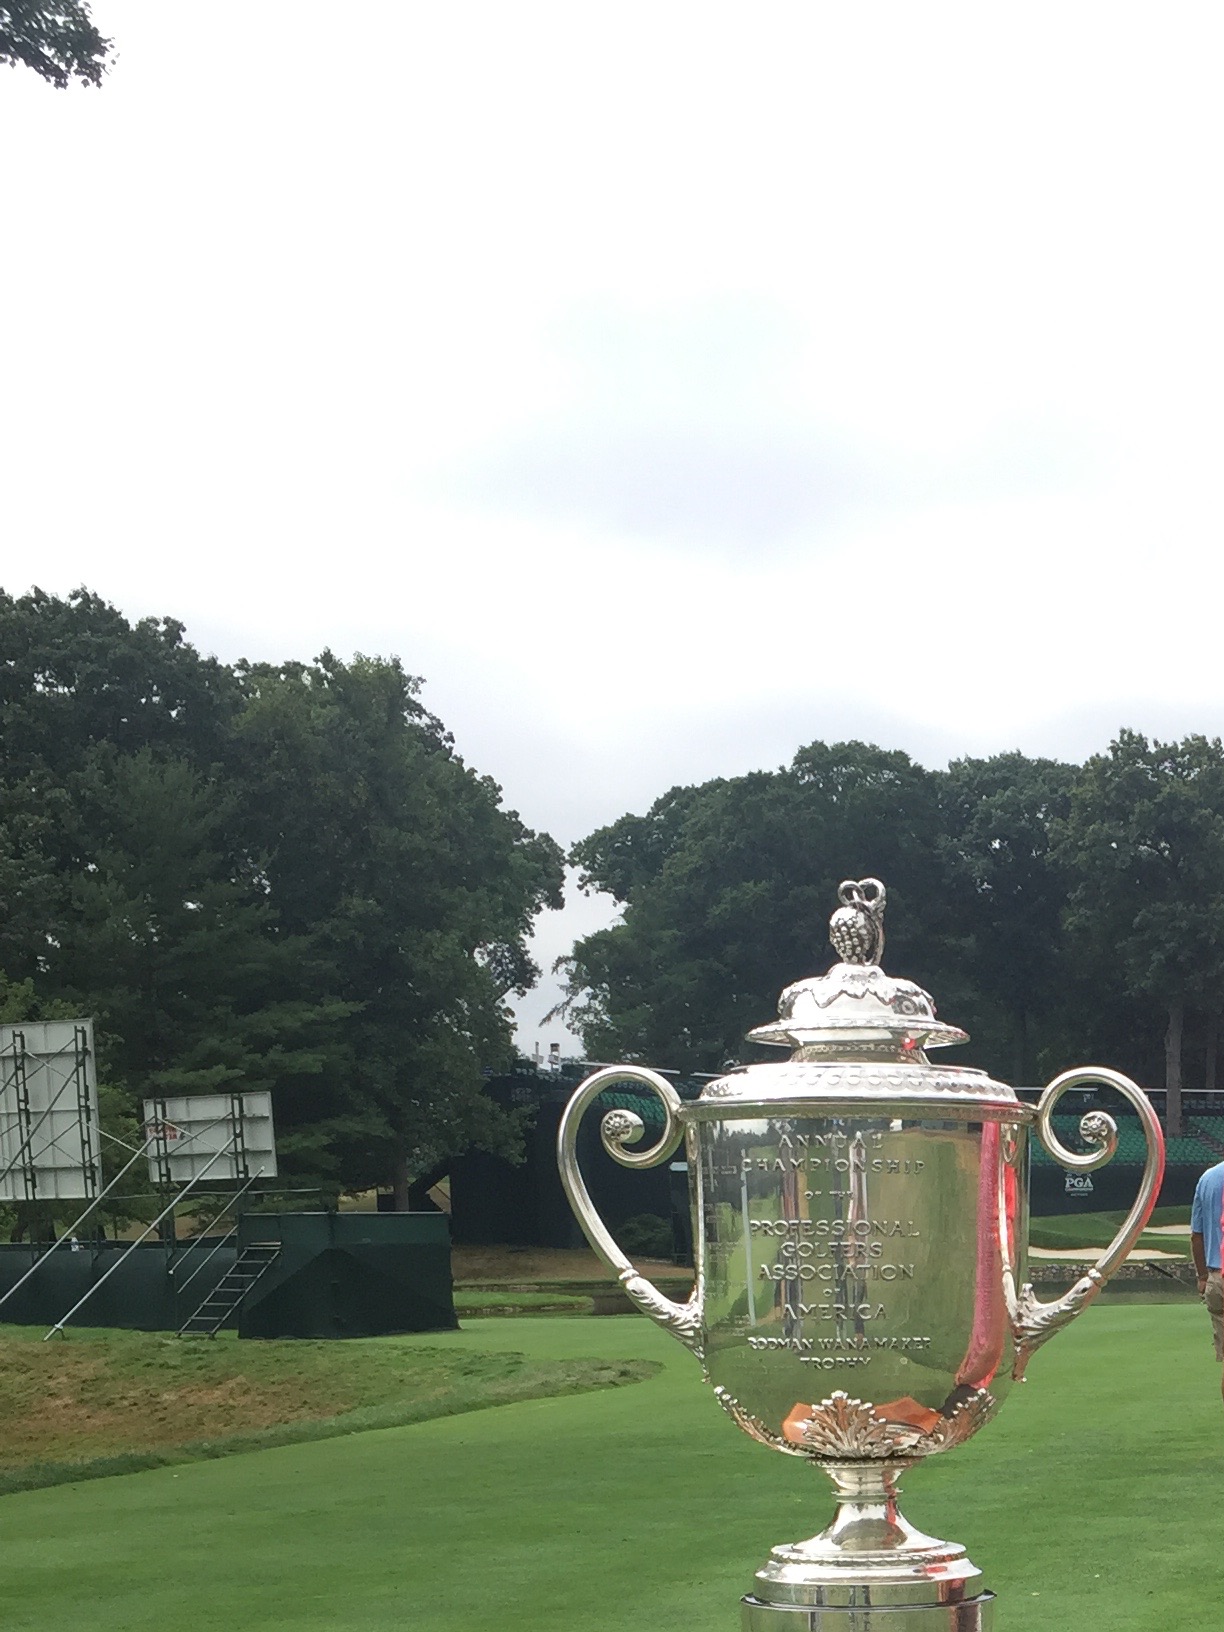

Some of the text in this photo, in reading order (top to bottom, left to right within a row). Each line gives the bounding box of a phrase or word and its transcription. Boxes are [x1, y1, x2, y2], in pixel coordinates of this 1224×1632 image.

[778, 1132, 884, 1149] ANNUAL
[741, 1158, 925, 1174] CHAMPIONSHIP
[1065, 1177, 1093, 1188] PGA
[749, 1220, 920, 1237] PROFESSIONAL
[780, 1241, 883, 1258] GOLFERS
[758, 1264, 915, 1280] ASSOCIATION
[784, 1303, 888, 1320] AMERICA
[748, 1336, 813, 1350] RODMAN
[800, 1356, 871, 1370] TROPHY
